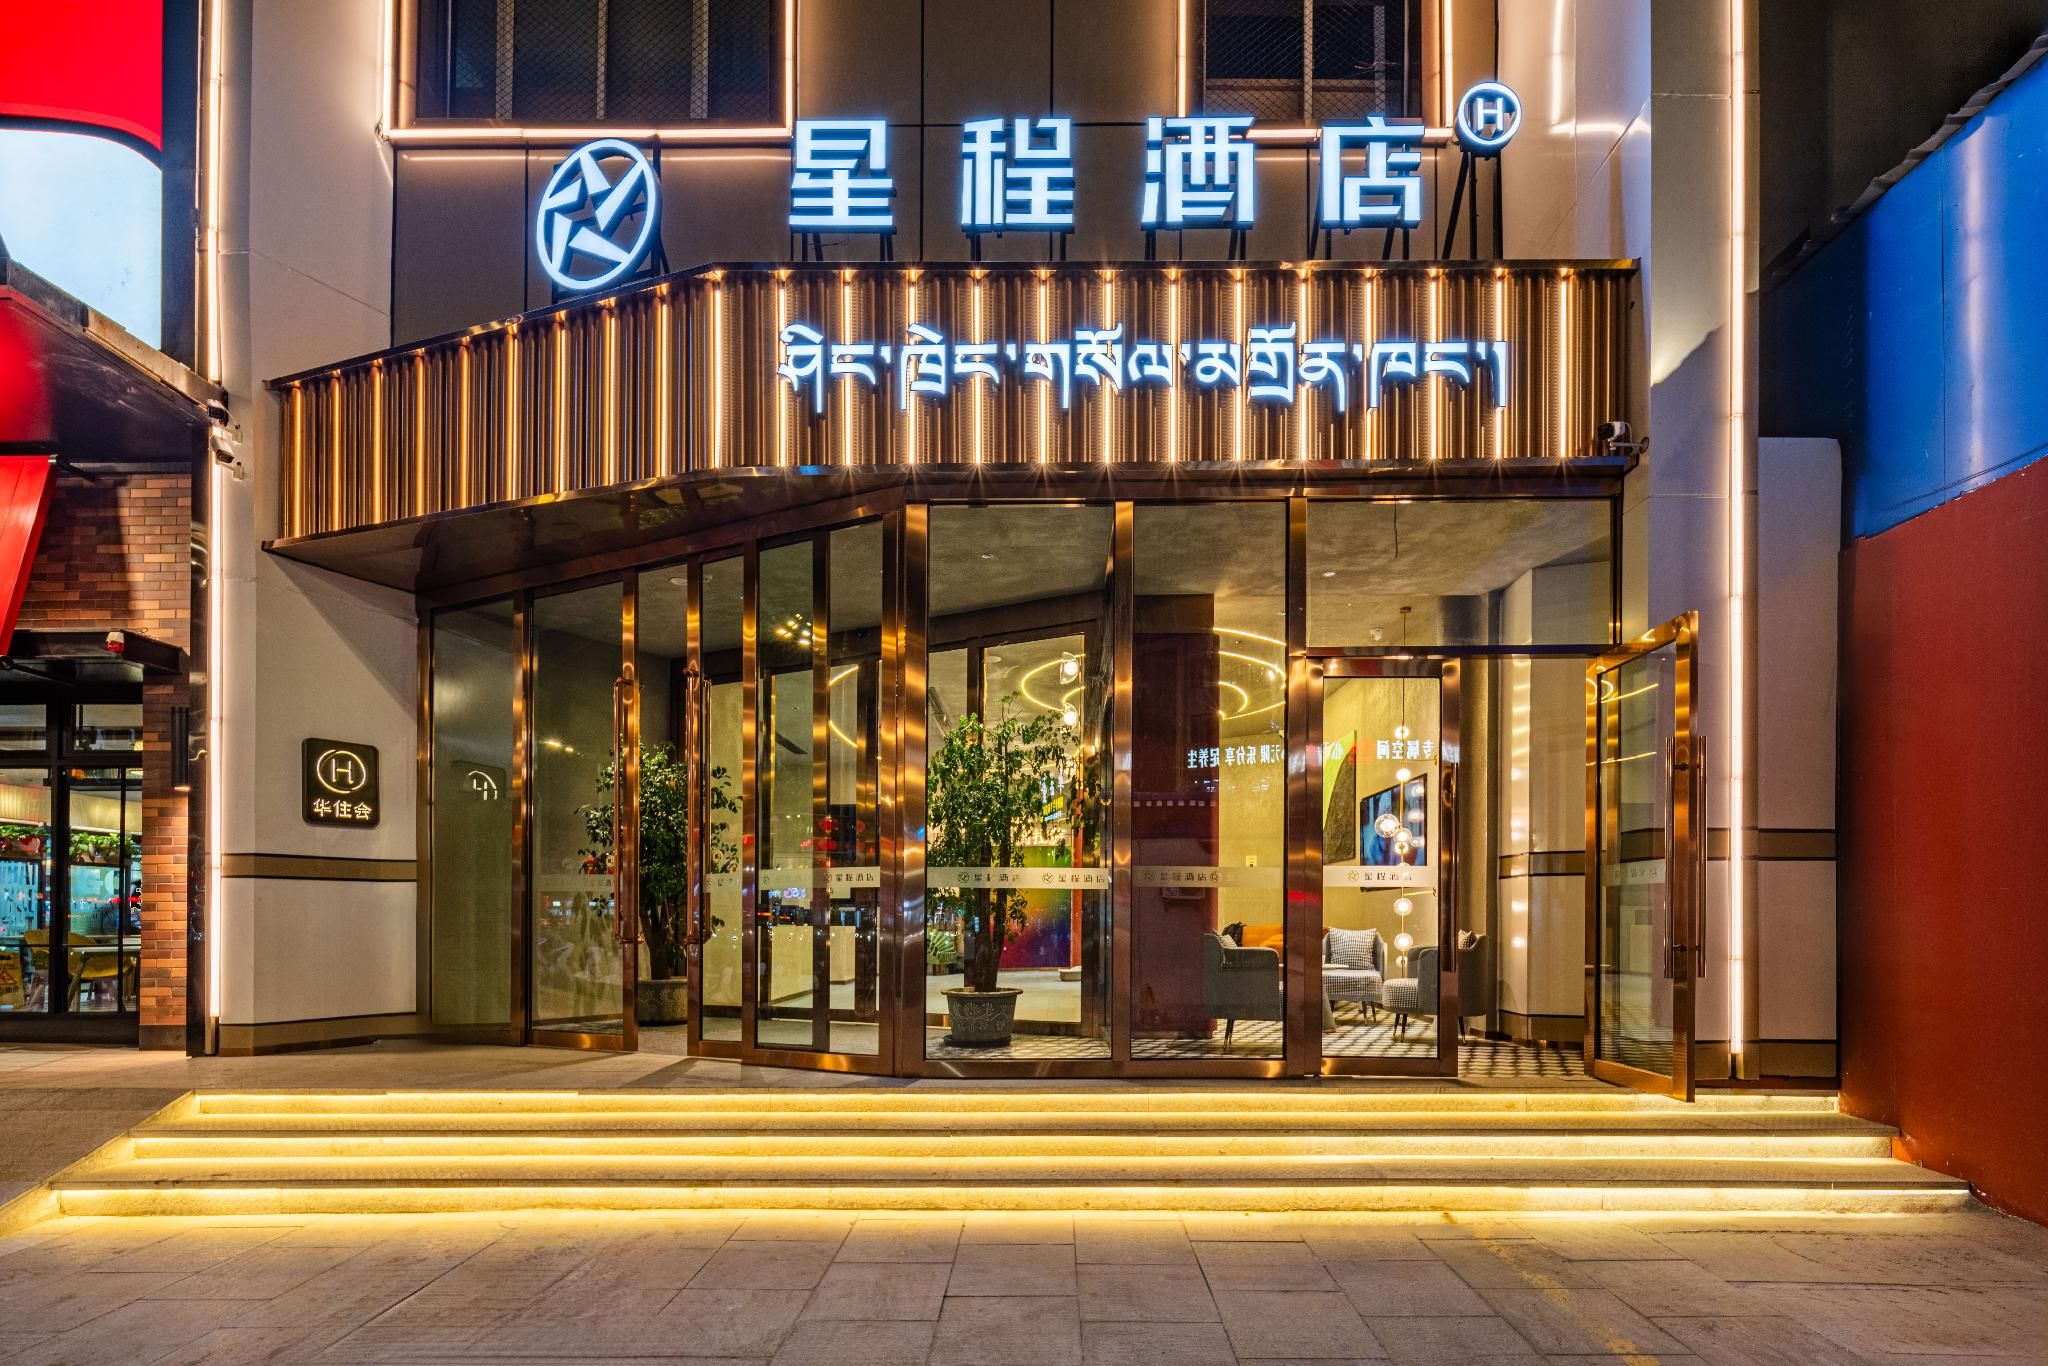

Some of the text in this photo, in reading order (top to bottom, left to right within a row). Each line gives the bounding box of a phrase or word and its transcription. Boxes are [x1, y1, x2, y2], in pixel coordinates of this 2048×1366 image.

[789, 115, 1425, 228] 星程酒店
[313, 797, 373, 820] 华住会
